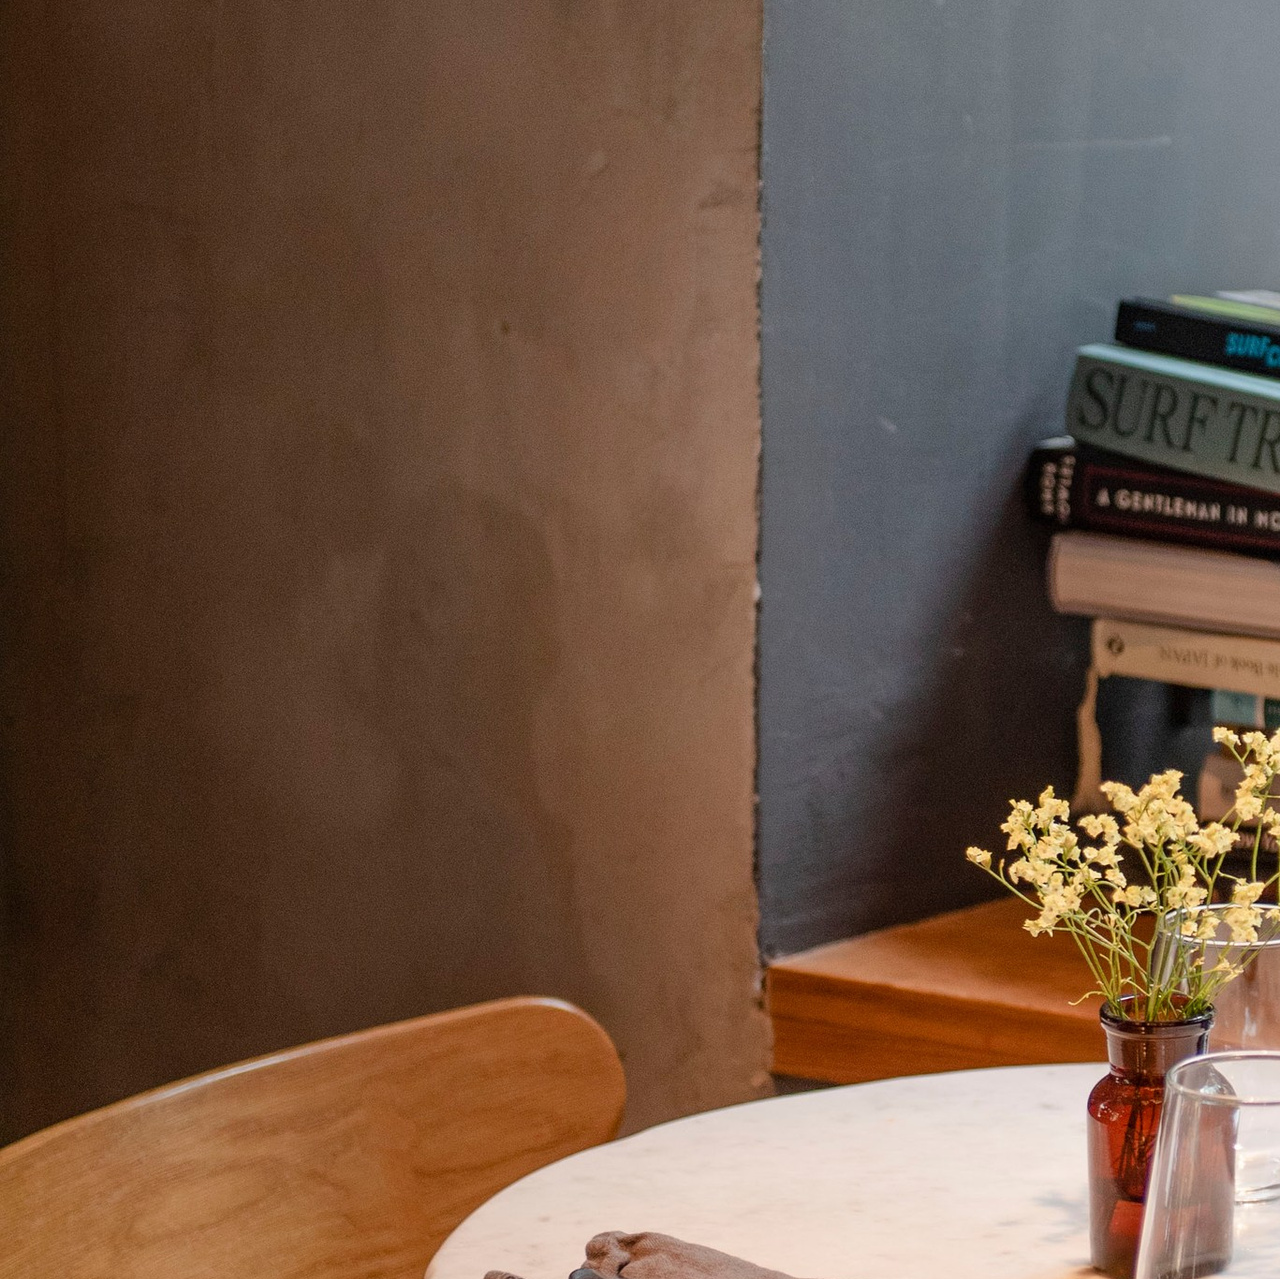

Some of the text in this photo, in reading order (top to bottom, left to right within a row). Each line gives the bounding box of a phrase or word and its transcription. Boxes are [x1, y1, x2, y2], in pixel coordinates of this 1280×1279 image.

[1225, 332, 1271, 359] SURF
[1077, 370, 1219, 453] SURF
[1096, 487, 1110, 507] A
[1114, 488, 1221, 522] GENTLEMAN
[1226, 504, 1248, 525] IN
[1230, 656, 1263, 673] Book
